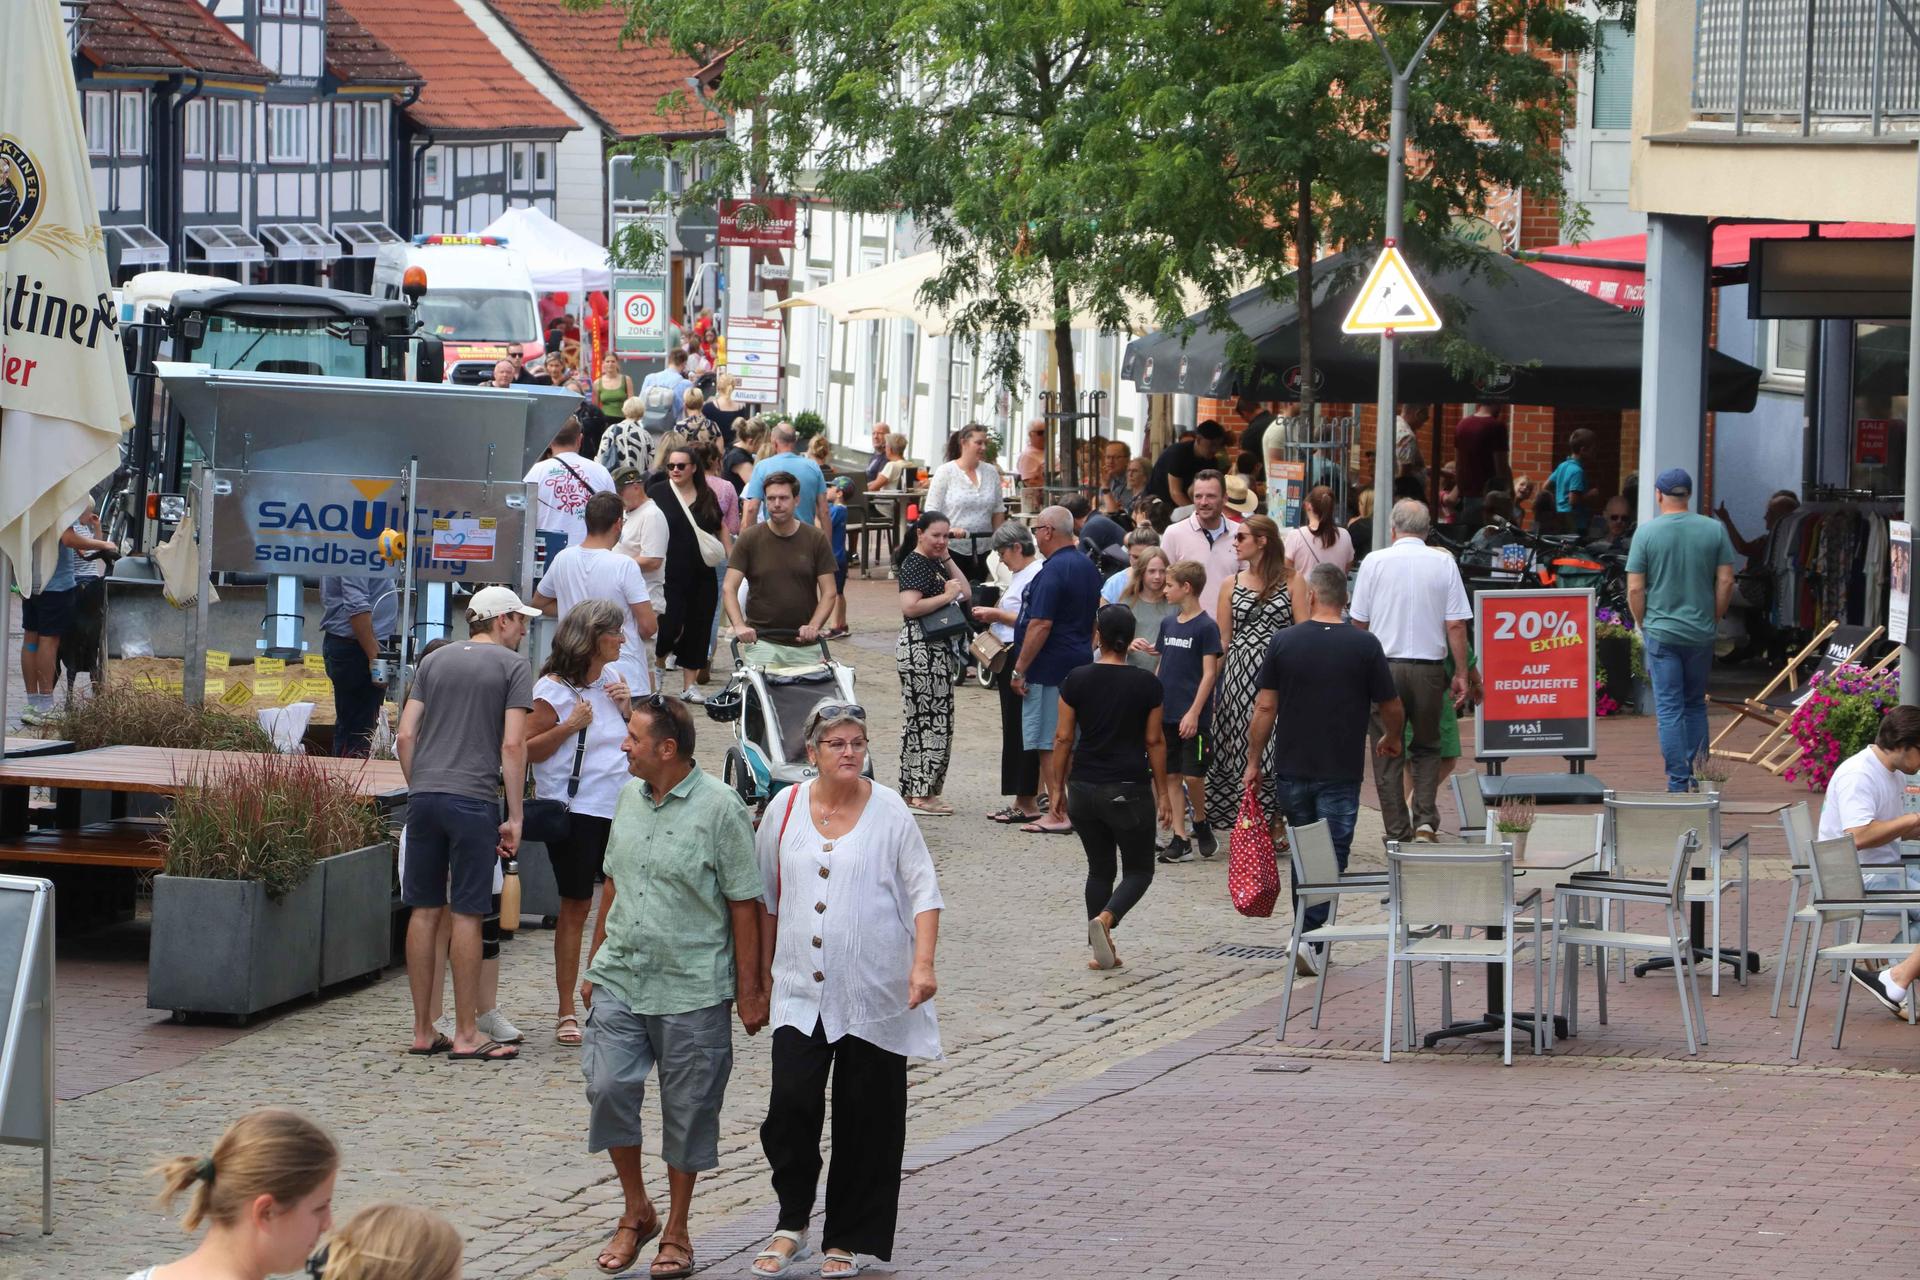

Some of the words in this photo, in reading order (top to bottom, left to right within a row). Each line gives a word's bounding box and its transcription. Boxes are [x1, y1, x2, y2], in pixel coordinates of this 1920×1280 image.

[0, 142, 37, 198] KTINER
[631, 302, 649, 317] 30
[628, 326, 652, 335] ZONE
[735, 390, 758, 400] Allianz
[1493, 611, 1578, 640] 20%
[1530, 633, 1584, 653] EXTRA
[1521, 664, 1551, 675] AUF
[1494, 678, 1579, 691] REDUZIERTE
[1515, 693, 1557, 705] WARE
[1508, 720, 1542, 735] mai
